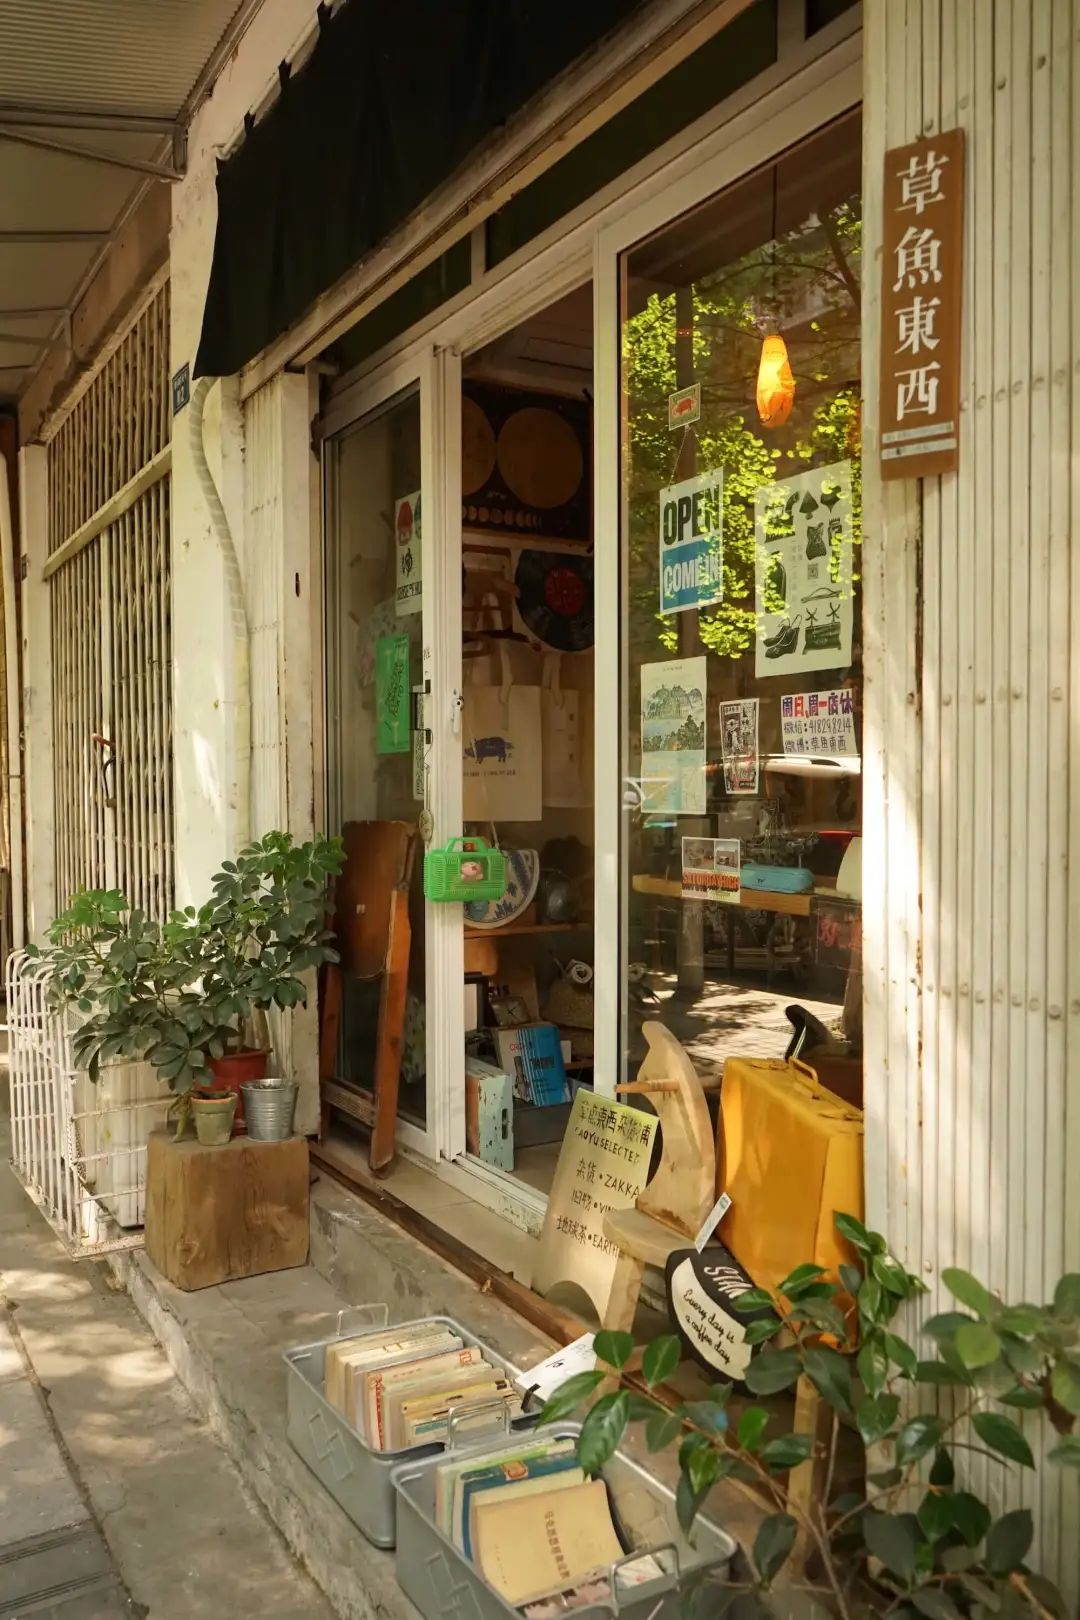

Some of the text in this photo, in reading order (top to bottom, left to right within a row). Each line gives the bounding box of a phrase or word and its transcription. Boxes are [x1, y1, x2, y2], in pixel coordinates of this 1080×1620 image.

[892, 150, 950, 422] 草魚東西
[663, 484, 720, 546] OPEN
[604, 1173, 640, 1200] ZAKKA
[683, 1289, 736, 1344] Every day is
[685, 1315, 730, 1365] a coffee day
